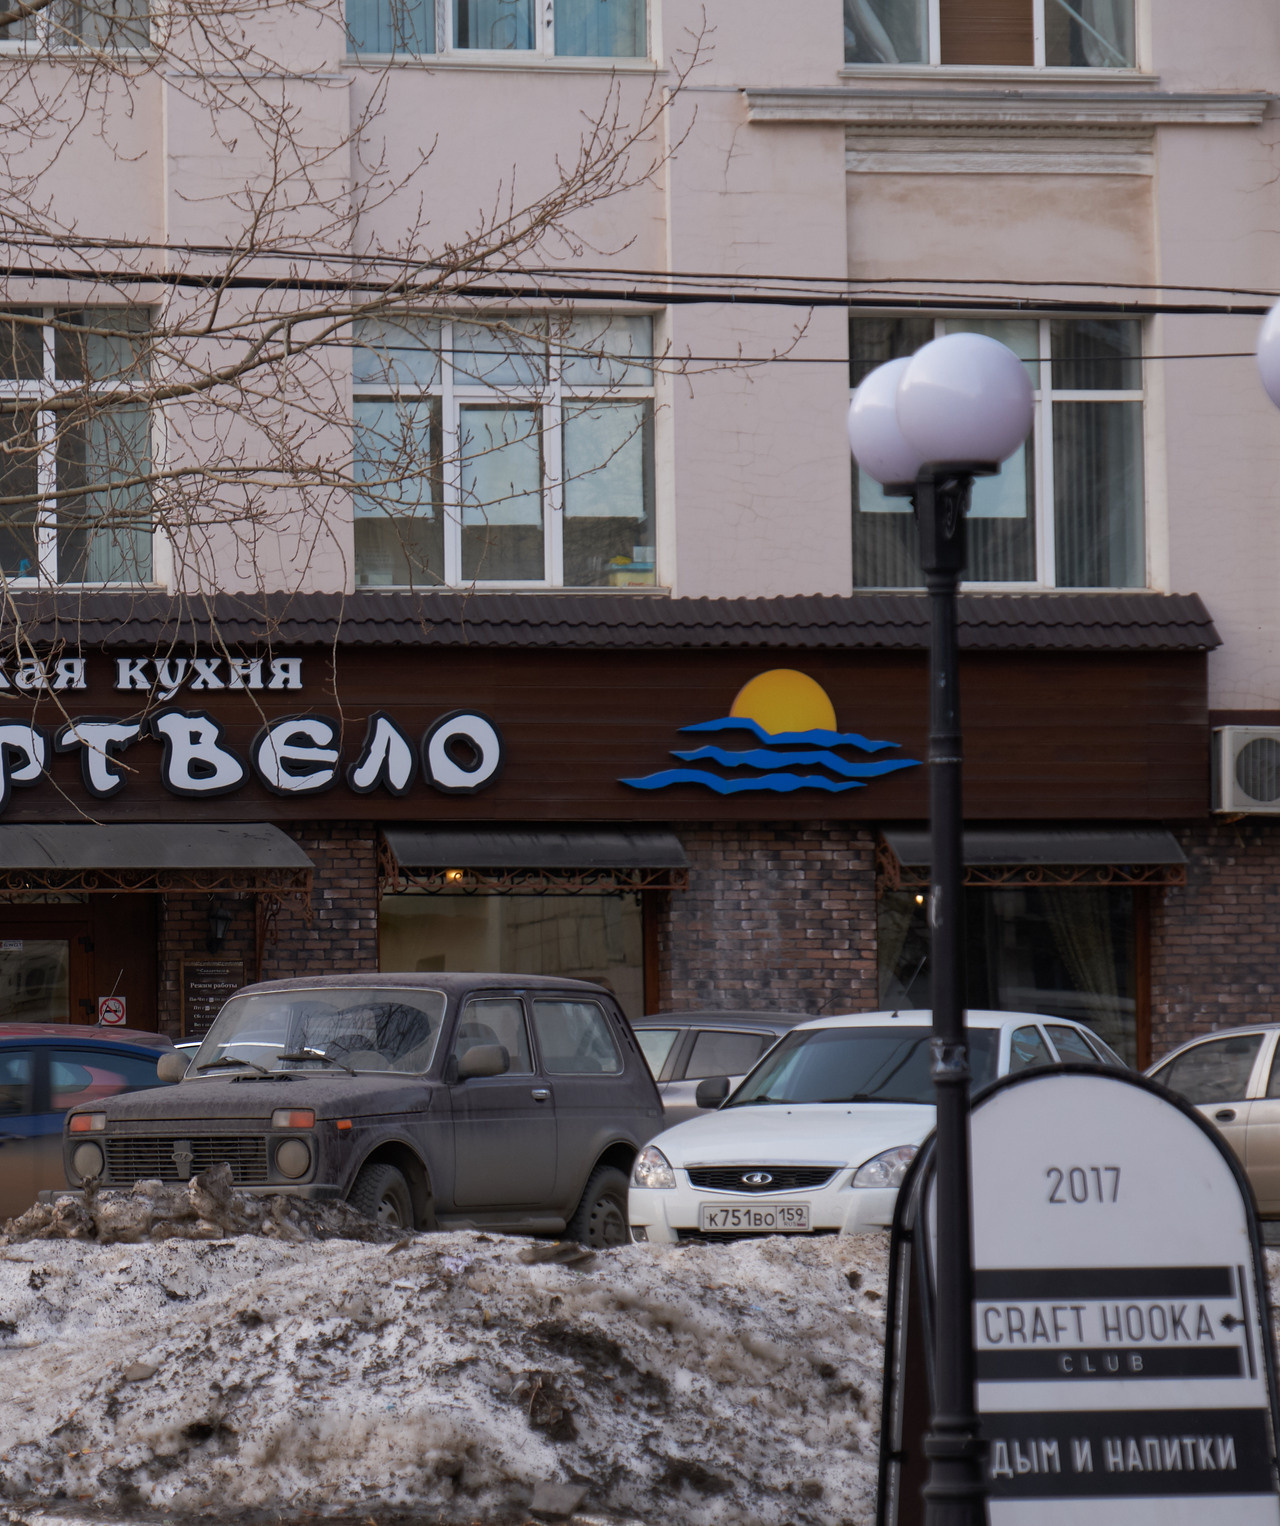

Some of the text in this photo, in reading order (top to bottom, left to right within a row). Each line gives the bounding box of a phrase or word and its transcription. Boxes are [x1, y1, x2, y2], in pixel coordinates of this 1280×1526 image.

[118, 656, 304, 700] кухня
[213, 982, 238, 990] работы
[1046, 1167, 1122, 1204] 2017
[779, 1207, 804, 1221] 159
[983, 1304, 1216, 1344] CRAFT HOOKA
[1062, 1356, 1144, 1373] CLUB
[992, 1437, 1237, 1479] ДЫМ И НАПИТКИ
